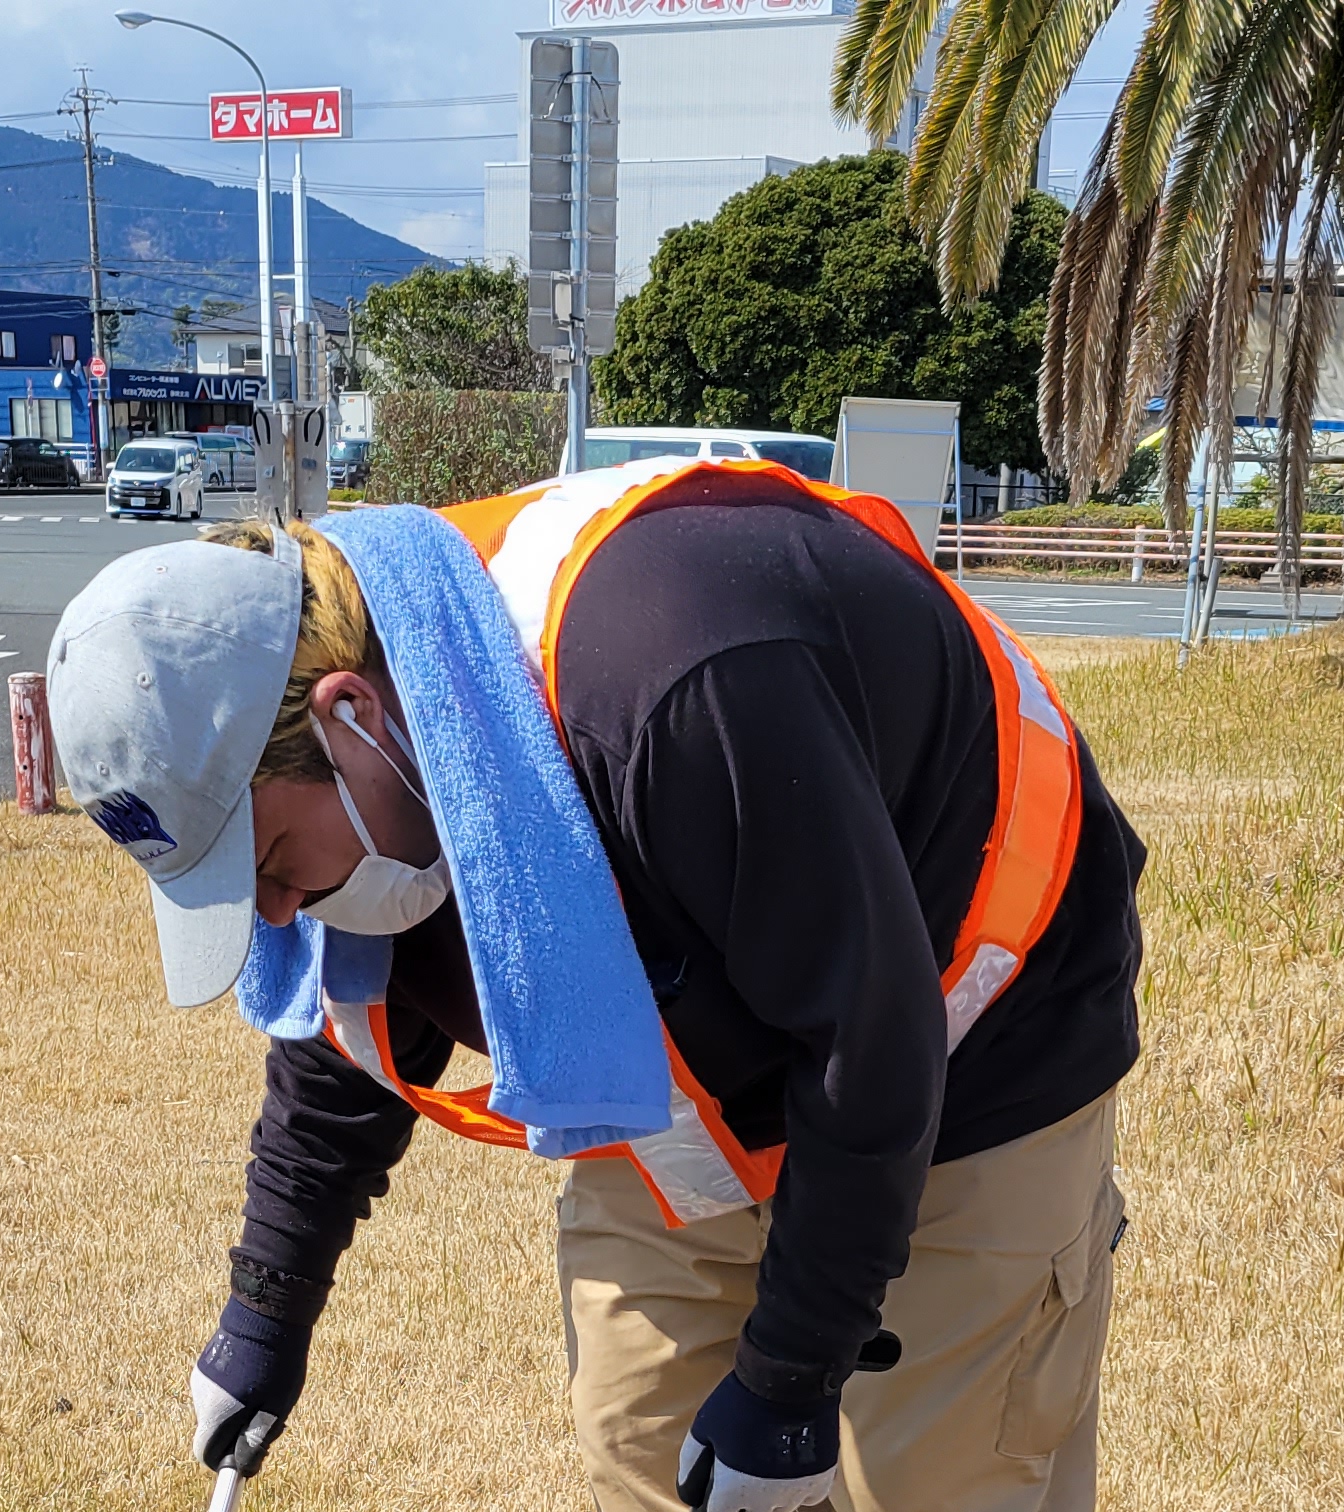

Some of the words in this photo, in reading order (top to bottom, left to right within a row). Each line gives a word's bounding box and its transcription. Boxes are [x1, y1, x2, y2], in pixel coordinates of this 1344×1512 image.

[214, 98, 337, 133] タマホーム
